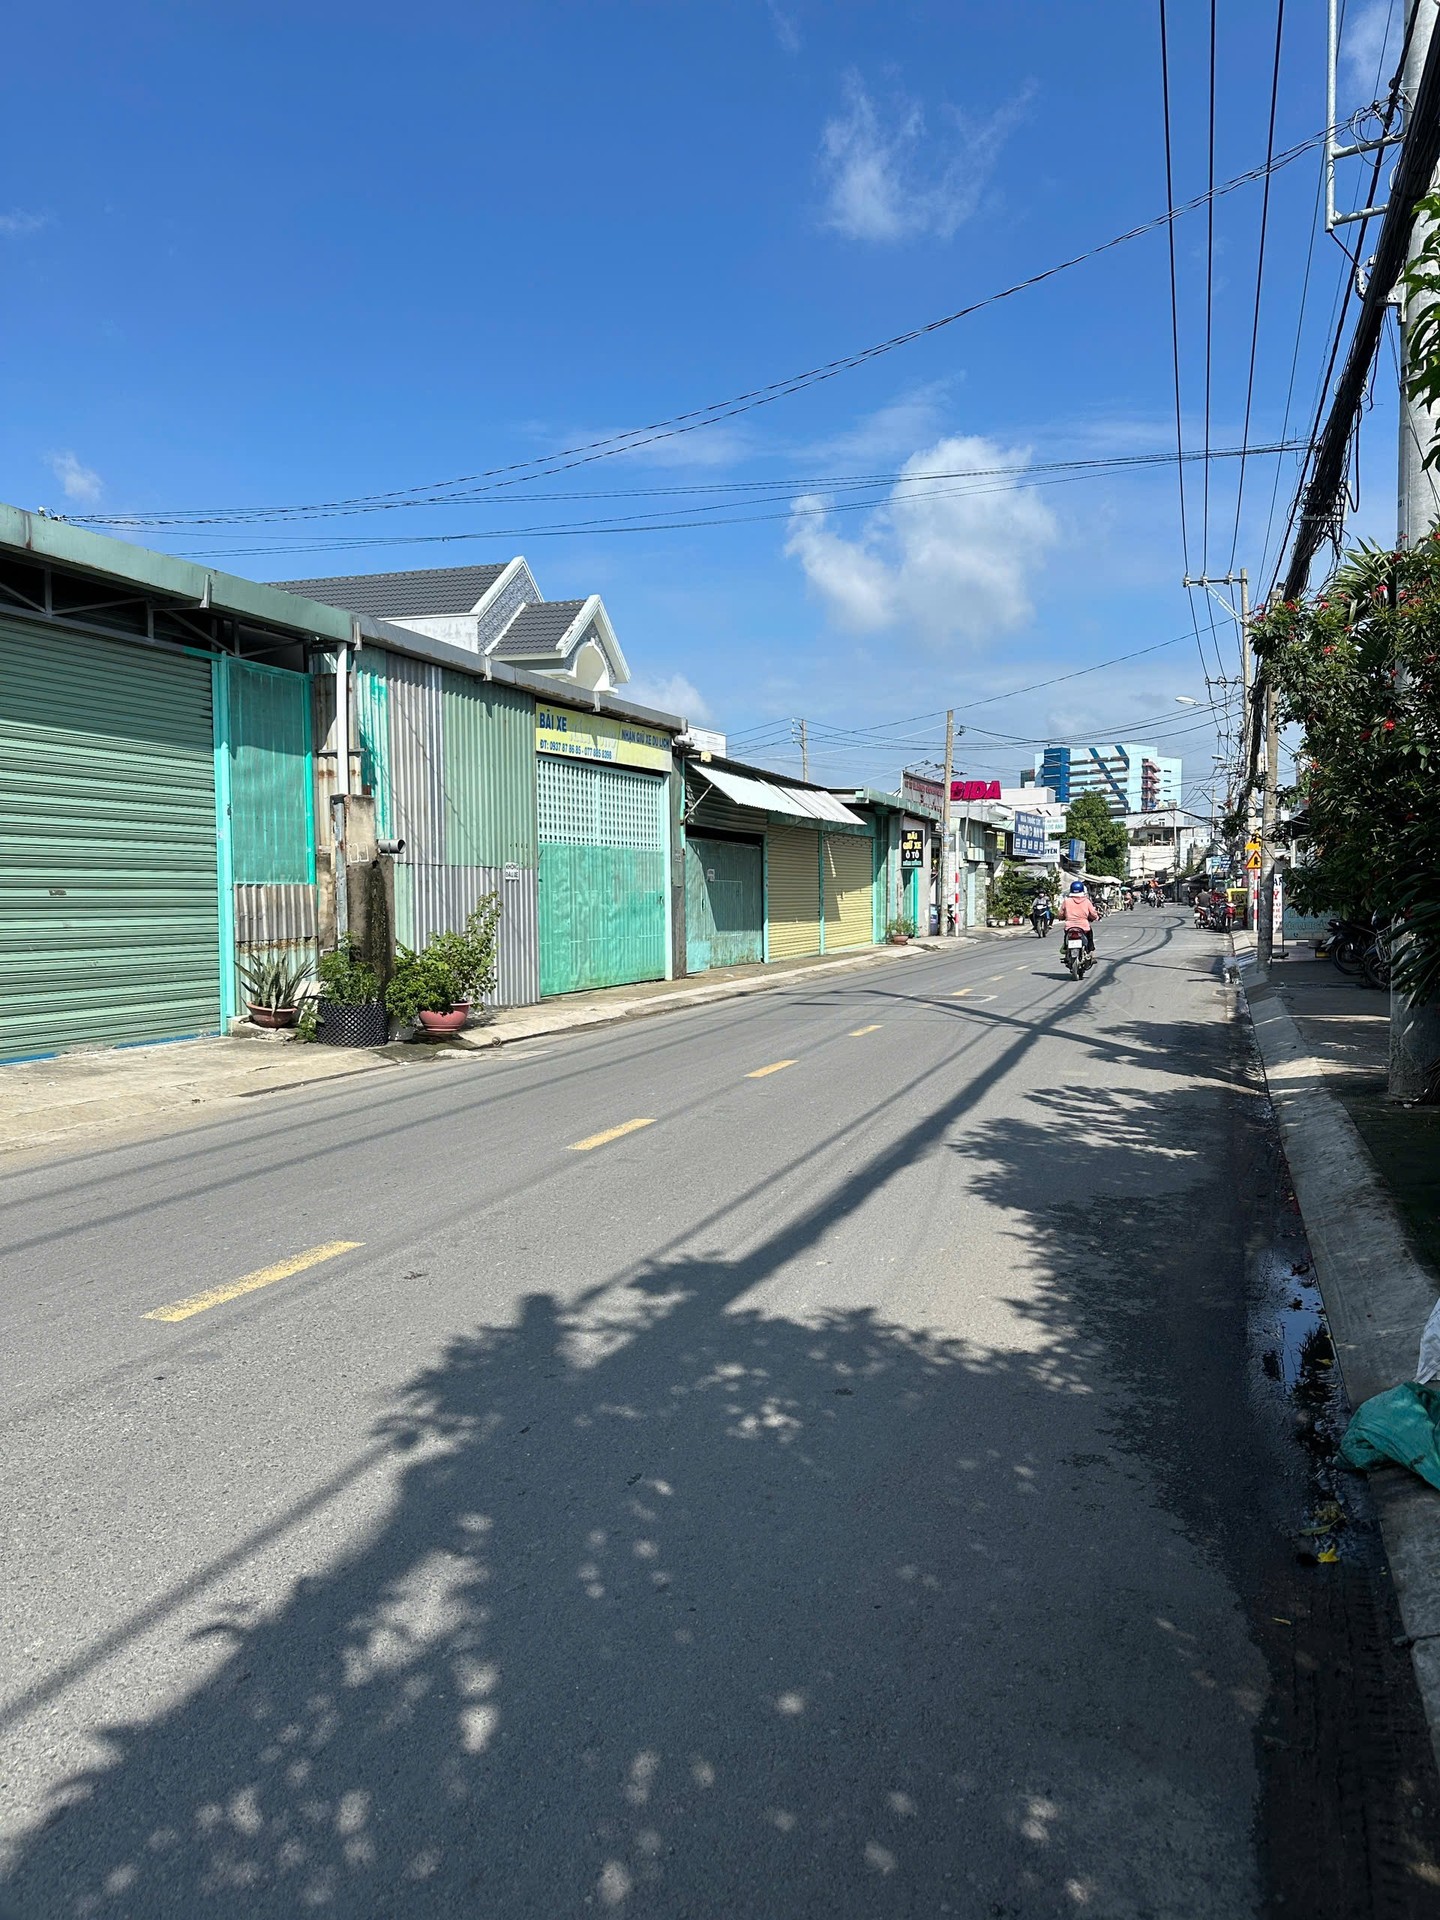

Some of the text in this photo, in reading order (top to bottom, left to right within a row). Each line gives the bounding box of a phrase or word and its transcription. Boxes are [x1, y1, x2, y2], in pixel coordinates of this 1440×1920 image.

[539, 708, 554, 730] BÃI
[557, 715, 567, 733] XE
[645, 734, 652, 745] XE
[951, 781, 1002, 801] BIDA
[913, 841, 922, 850] XE
[911, 849, 920, 859] TÔ
